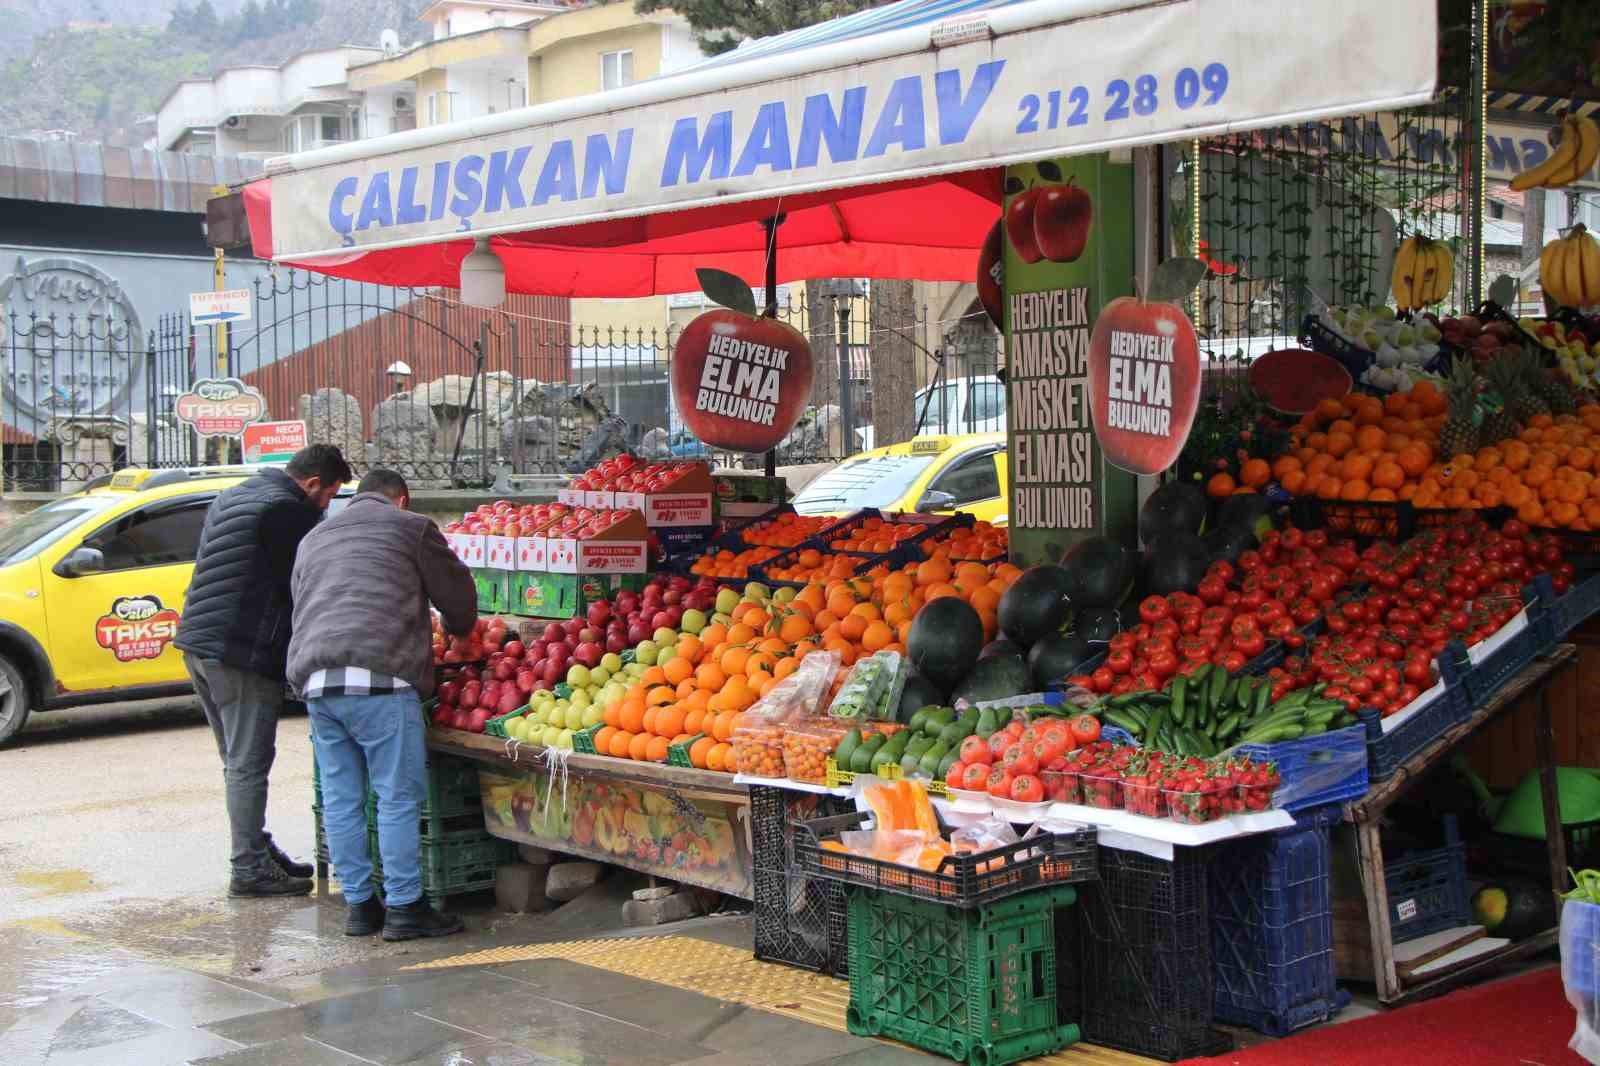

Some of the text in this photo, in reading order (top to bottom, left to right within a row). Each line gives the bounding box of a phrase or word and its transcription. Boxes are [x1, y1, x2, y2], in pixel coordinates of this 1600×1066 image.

[329, 59, 1229, 248] ÇALIŞKAN MANAV 212 28 09
[1010, 328, 1089, 377] AMASYA
[700, 354, 780, 404] ELMA
[1108, 357, 1172, 408] ELMA
[696, 388, 776, 426] BULUNUR
[1108, 400, 1170, 437] BULUNUR
[1015, 432, 1092, 483] ELMASI
[1015, 487, 1092, 528] BULUNUR
